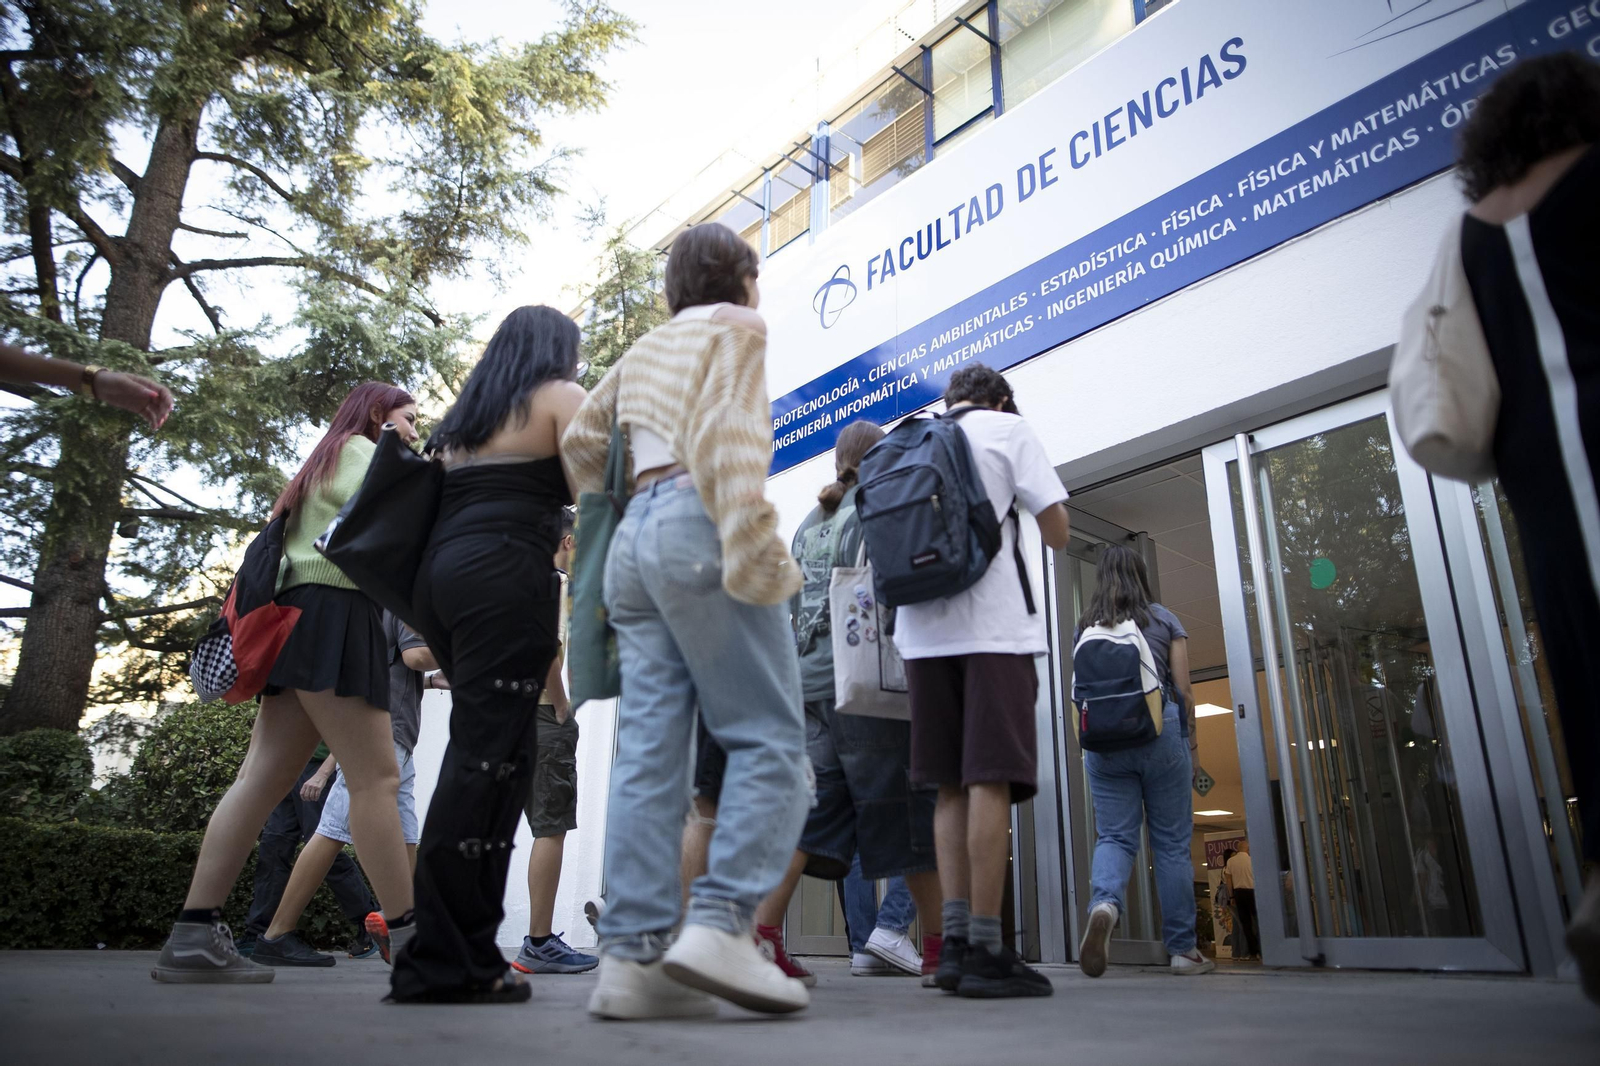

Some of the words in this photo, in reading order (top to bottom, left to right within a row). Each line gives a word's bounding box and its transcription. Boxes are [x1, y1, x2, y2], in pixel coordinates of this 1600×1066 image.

[772, 413, 832, 453] INGENIERÍA
[835, 372, 919, 422] INFORMÁTICA
[921, 365, 930, 379] Y
[933, 315, 1035, 375] MATEMÁTICAS
[1047, 261, 1147, 320] INGENIERÍA
[1150, 218, 1237, 269] QUÍMICA
[1253, 127, 1420, 221] MATEMÁTICAS
[1440, 90, 1490, 128] ÓP
[773, 377, 860, 430] BIOTECNOLOGÍA
[868, 343, 927, 382] CIENCIAS
[930, 292, 1028, 352] AMBIENTALES
[1040, 232, 1147, 296] ESTADÍSTICA
[1161, 194, 1224, 236] FÍSICA
[1237, 152, 1307, 197] FÍSICA
[1309, 139, 1325, 159] Y
[1331, 44, 1517, 151] MATEMÁTICAS
[866, 182, 1004, 291] FACULTAD
[1016, 147, 1058, 202] DE
[1069, 36, 1248, 169] CIENCIAS
